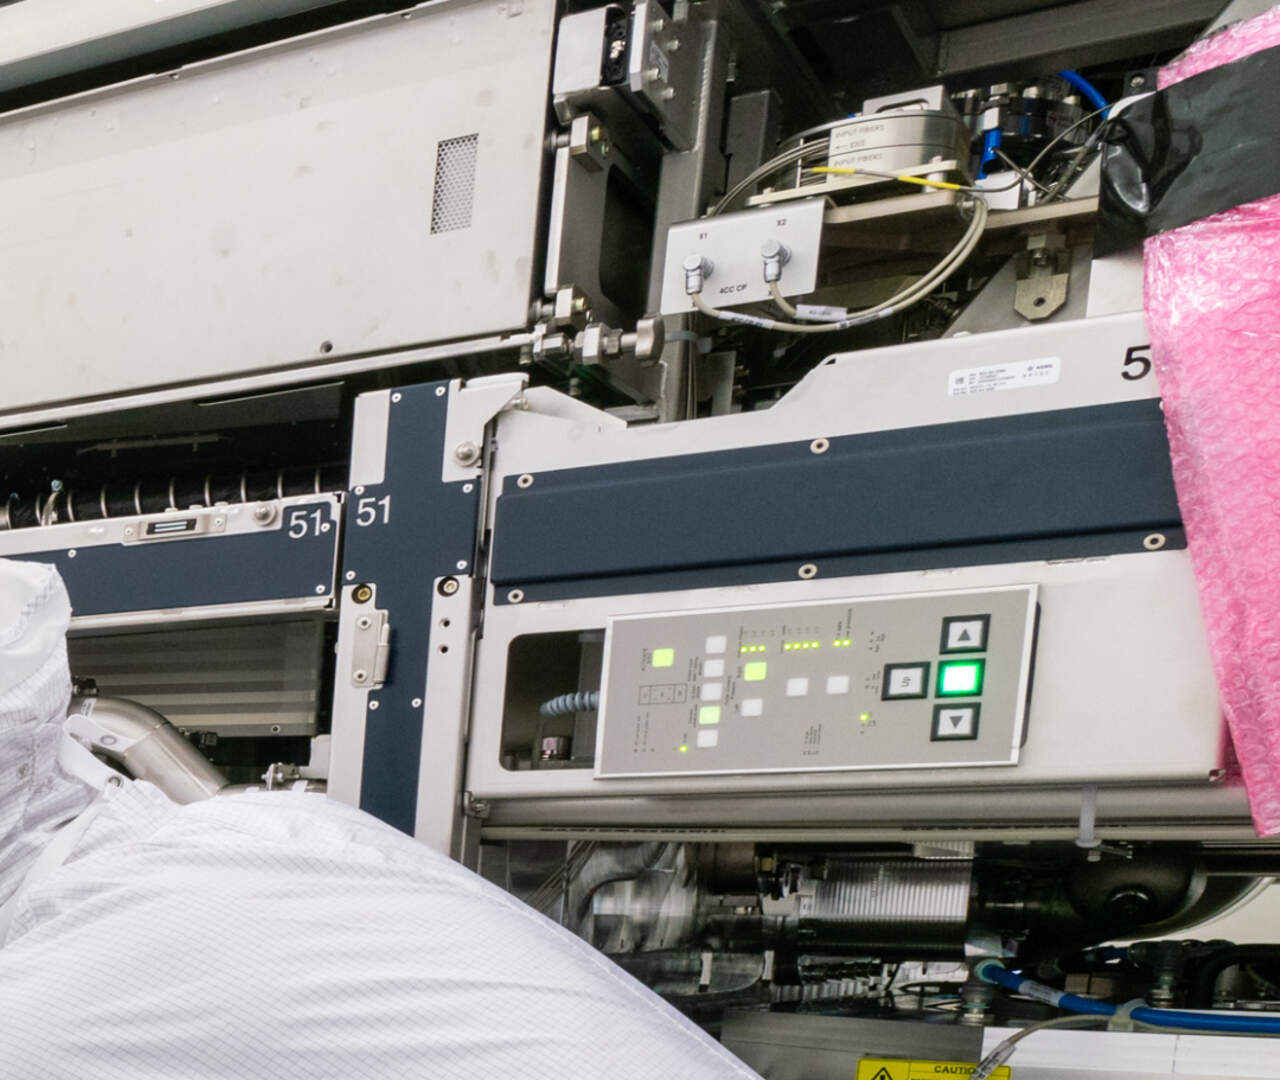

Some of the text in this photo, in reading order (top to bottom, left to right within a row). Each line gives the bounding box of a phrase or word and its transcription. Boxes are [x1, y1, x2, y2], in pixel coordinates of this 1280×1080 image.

[776, 218, 787, 227] X2
[699, 232, 708, 240] X1
[356, 495, 391, 527] 51
[288, 509, 321, 539] 51
[901, 676, 912, 688] Up
[934, 1064, 976, 1075] CAUTIO
